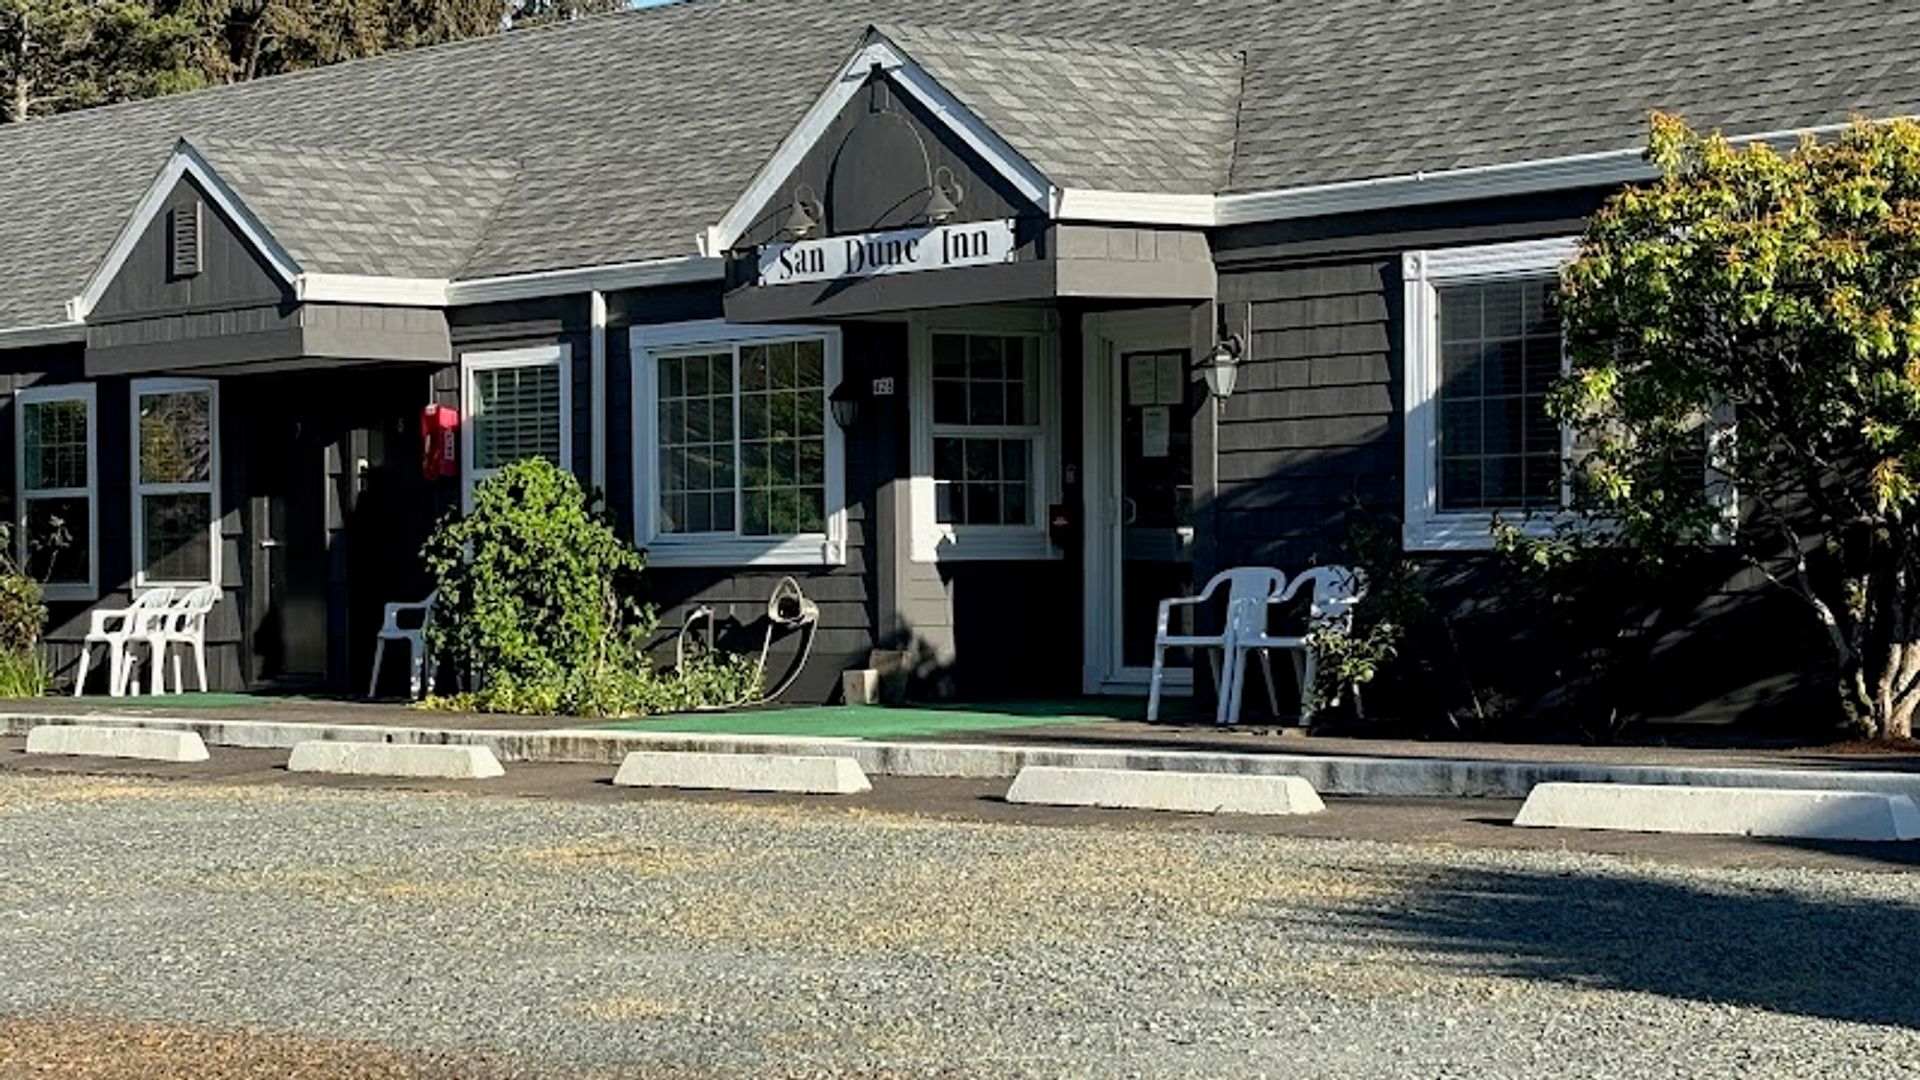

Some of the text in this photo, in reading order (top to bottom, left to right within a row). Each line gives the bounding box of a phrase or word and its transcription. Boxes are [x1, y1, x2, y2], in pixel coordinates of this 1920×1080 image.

[779, 229, 989, 280] San Dune Inn
